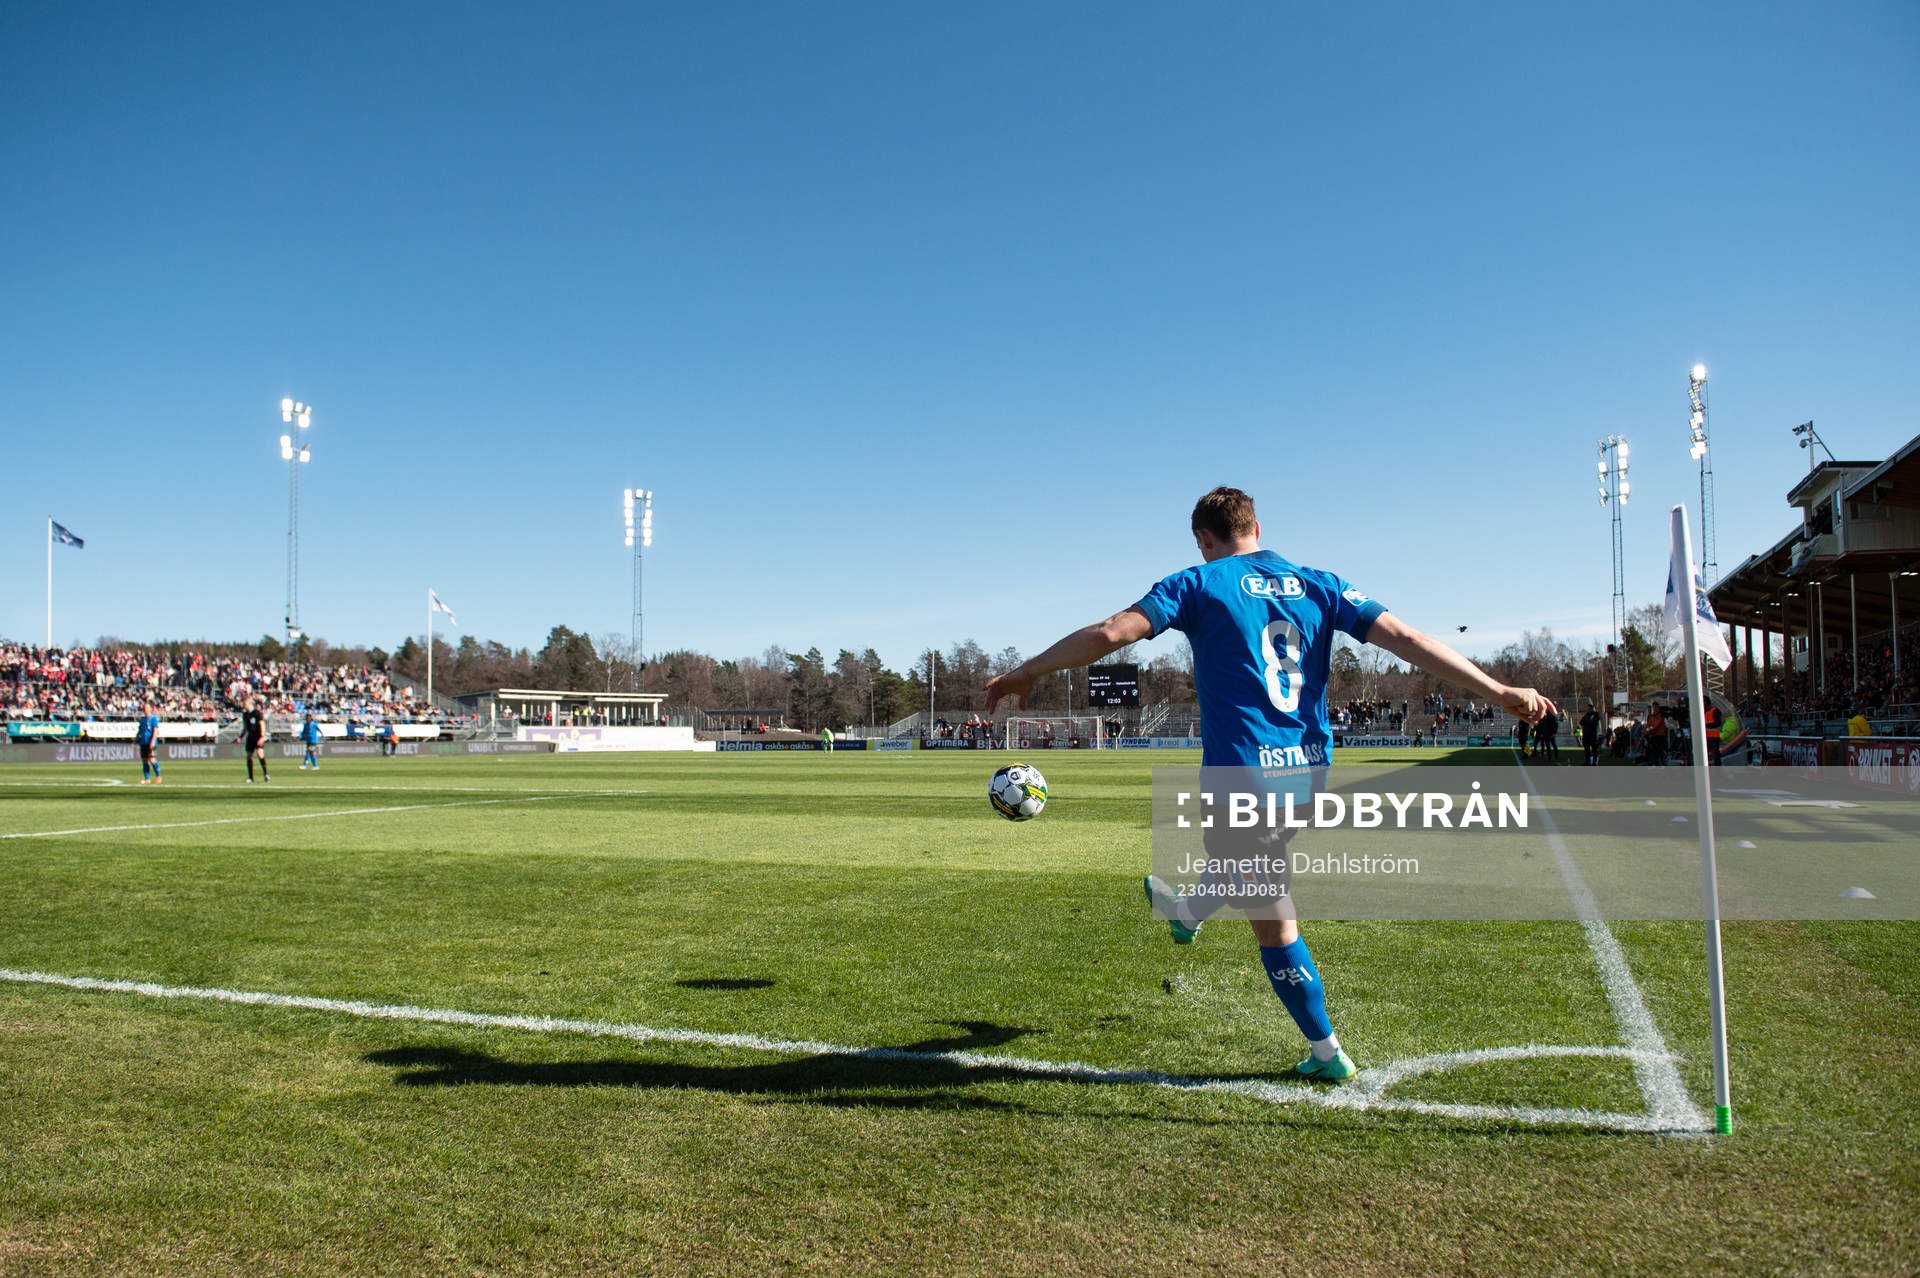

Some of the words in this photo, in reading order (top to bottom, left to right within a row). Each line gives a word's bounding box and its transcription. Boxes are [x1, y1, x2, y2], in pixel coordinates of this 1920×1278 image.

[1246, 576, 1303, 596] EAB
[1262, 620, 1303, 712] 8
[717, 741, 764, 751] Helmia
[926, 739, 969, 747] OPTIMERA
[1344, 737, 1410, 746] Vänerbuss
[69, 746, 135, 761] ALLSVENSKAN
[168, 745, 216, 759] UNIBET
